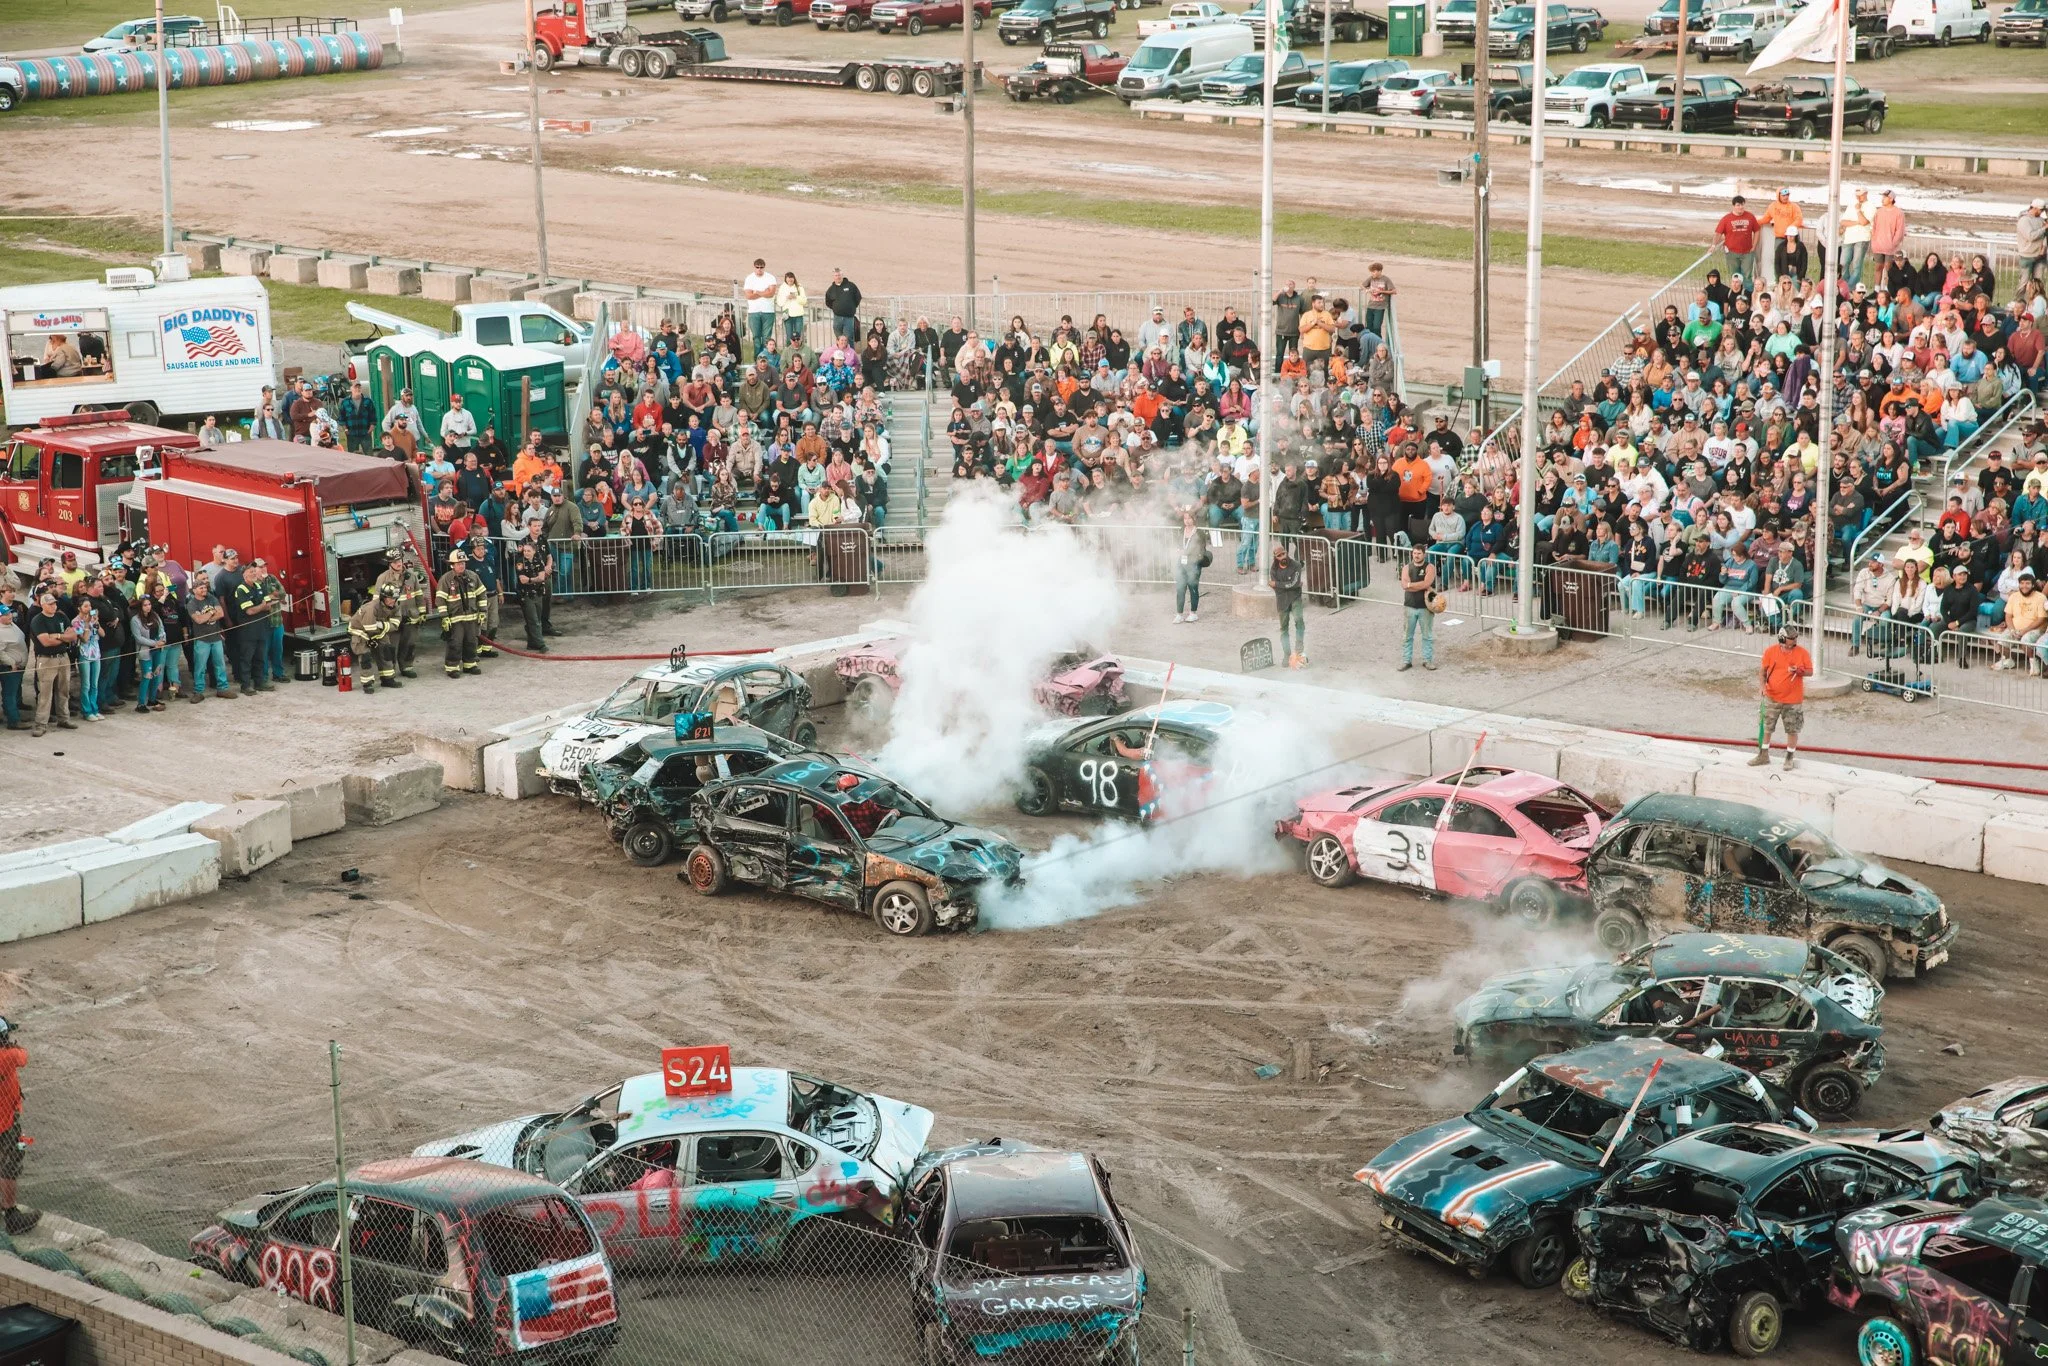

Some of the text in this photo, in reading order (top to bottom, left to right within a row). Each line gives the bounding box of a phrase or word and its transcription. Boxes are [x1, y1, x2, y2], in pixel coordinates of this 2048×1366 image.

[61, 314, 83, 325] MILD
[163, 308, 256, 333] BIG DADDY'S
[166, 357, 260, 370] SAUSAGE HOUSE AND MORE
[58, 508, 73, 522] 203
[670, 644, 686, 667] 63
[1079, 759, 1119, 808] 98
[667, 1055, 728, 1087] S24
[980, 1294, 1101, 1316] GARAGE
